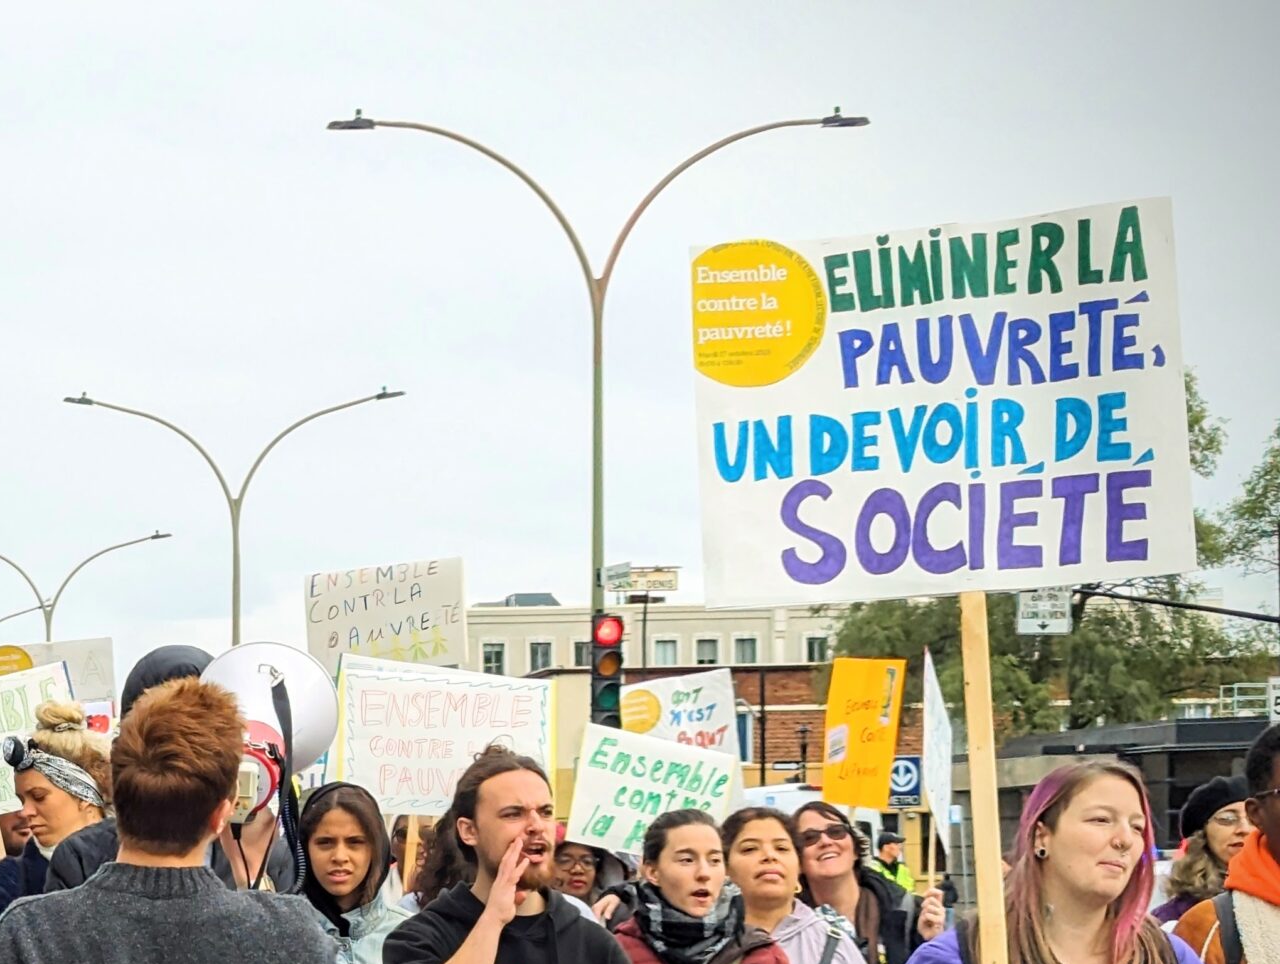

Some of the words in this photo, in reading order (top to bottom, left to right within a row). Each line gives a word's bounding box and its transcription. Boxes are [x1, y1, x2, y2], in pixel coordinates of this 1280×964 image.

[1076, 205, 1149, 286] LA
[696, 264, 788, 284] Ensemble
[696, 295, 758, 312] contre
[760, 292, 778, 310] la
[712, 414, 794, 483] UN
[1054, 390, 1133, 464] DE
[310, 560, 440, 598] ENSEMBLE
[360, 689, 534, 729] ENSEMBLE
[369, 735, 455, 760] CONTRE
[587, 736, 729, 798] Ensemble
[580, 804, 616, 838] la
